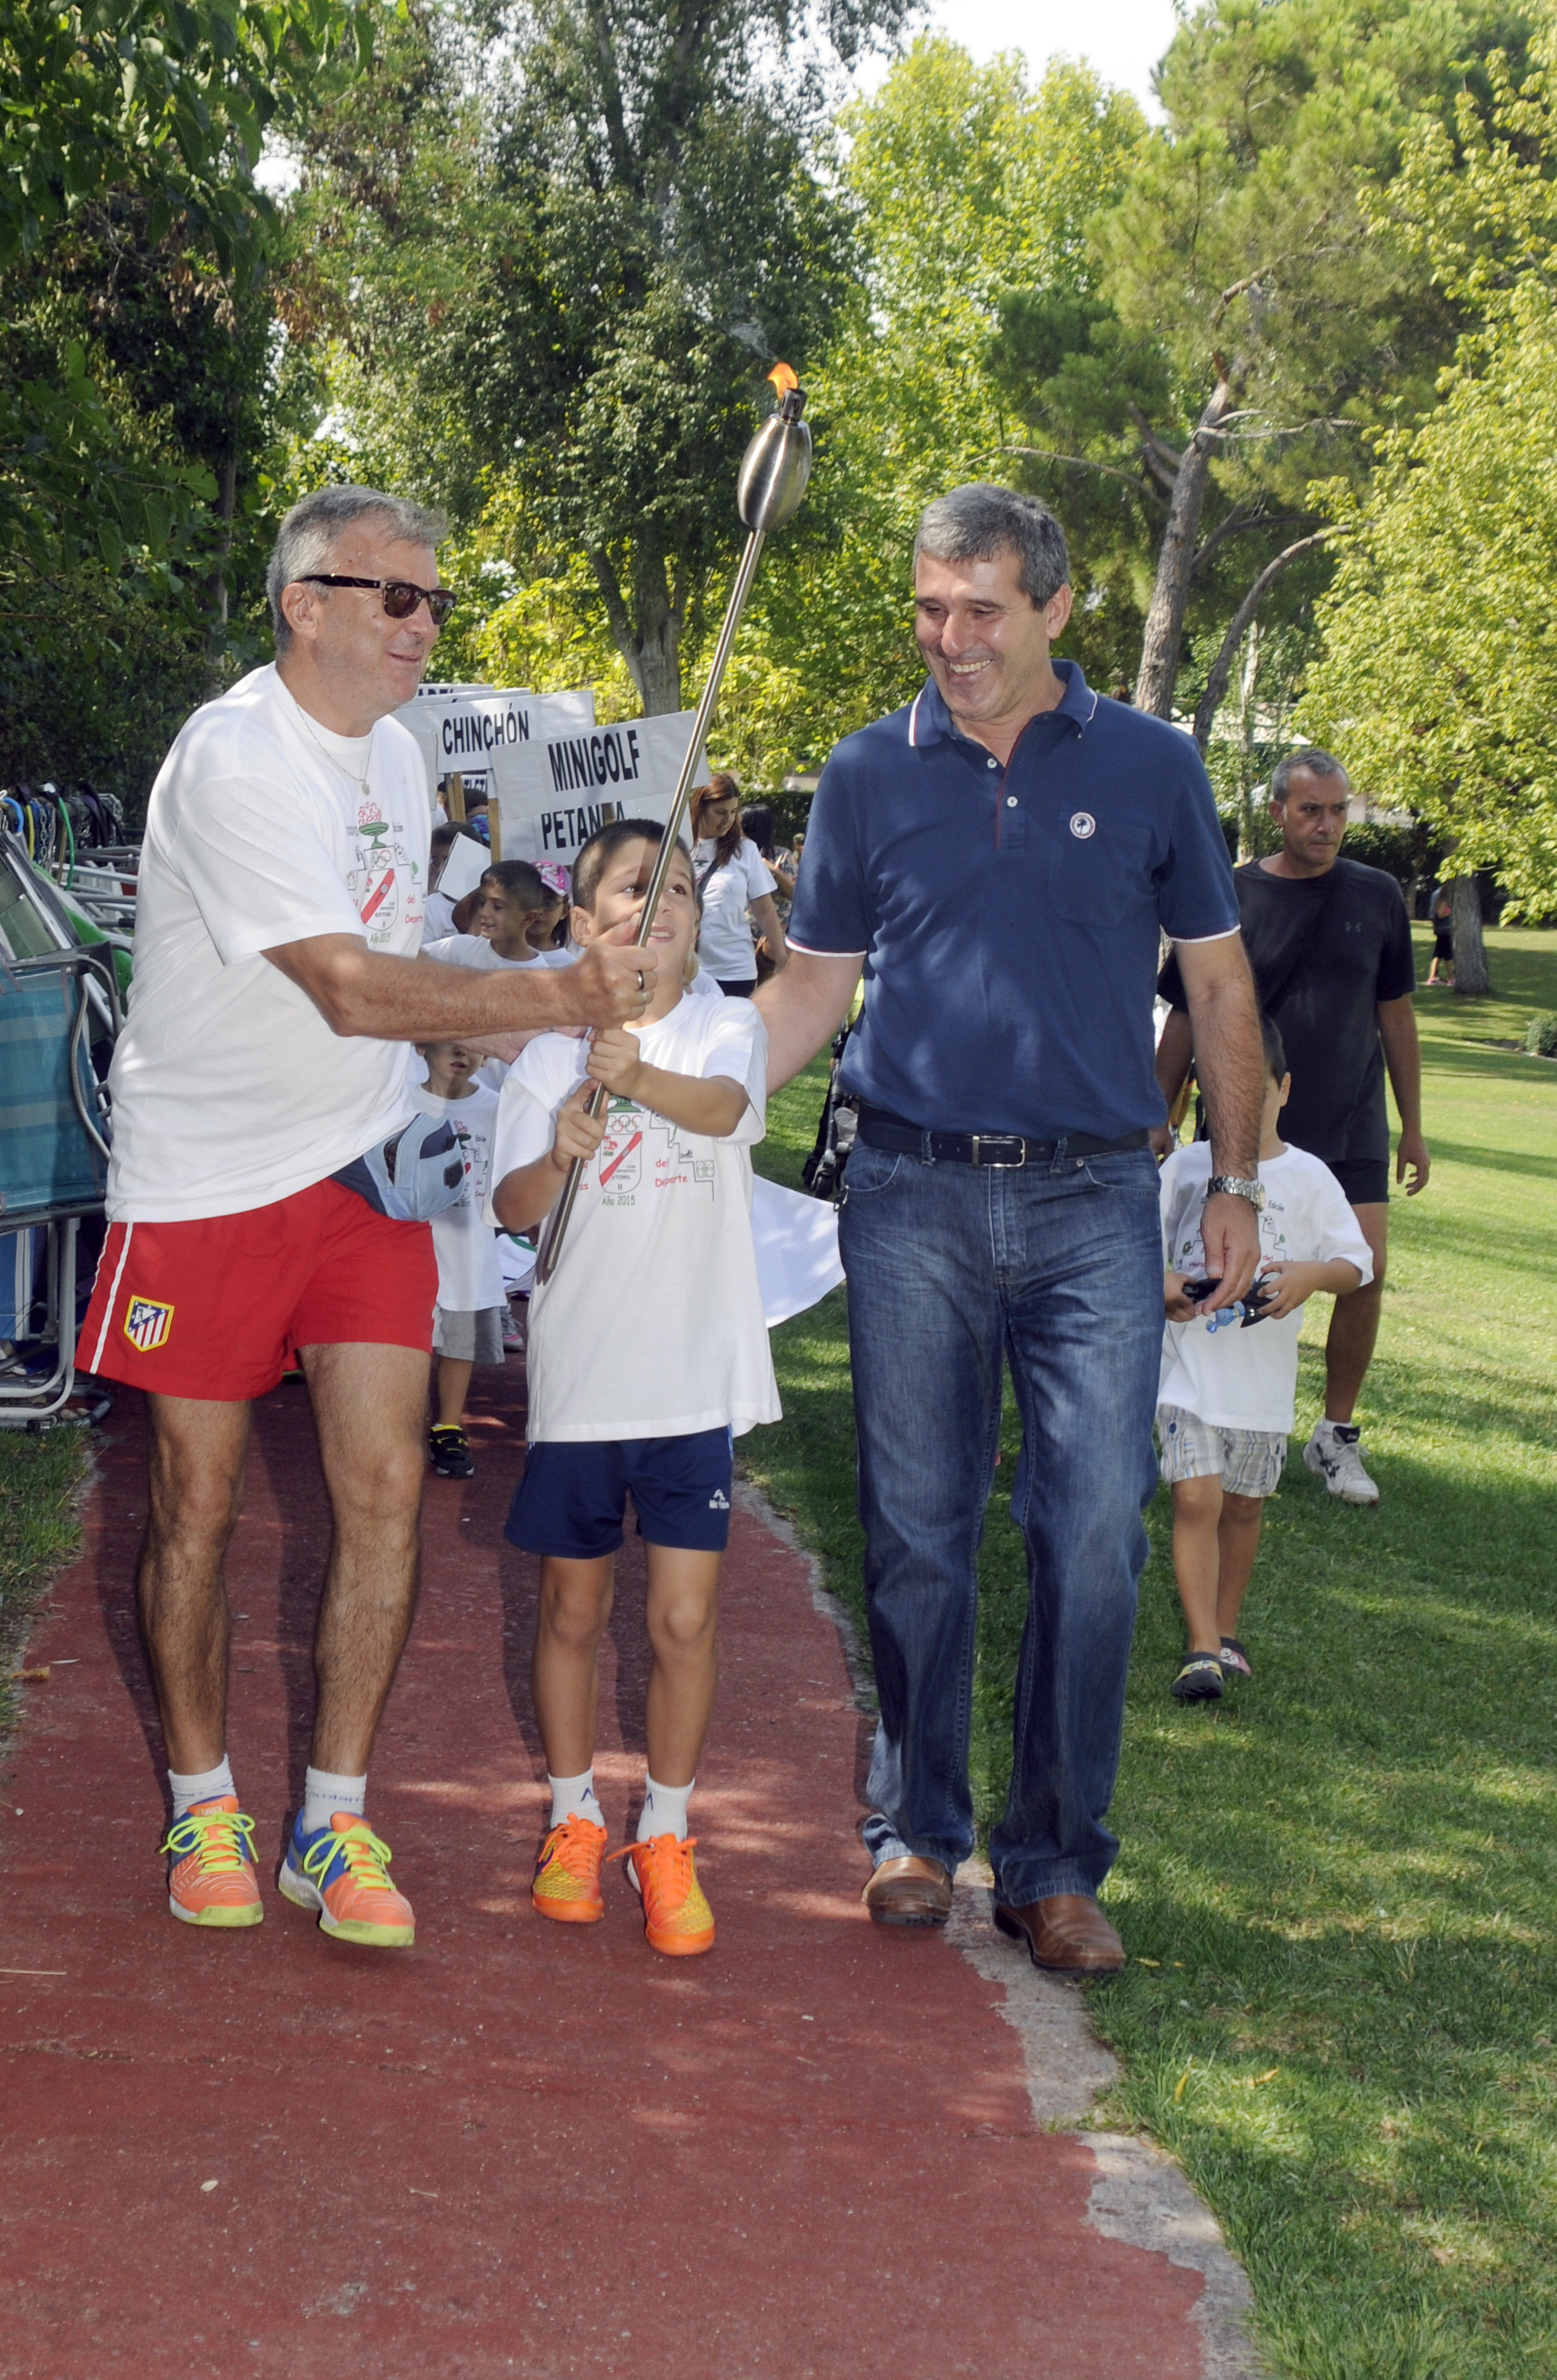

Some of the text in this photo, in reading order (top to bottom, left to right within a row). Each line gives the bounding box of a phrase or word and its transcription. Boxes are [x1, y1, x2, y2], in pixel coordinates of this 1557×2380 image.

[443, 702, 529, 755] CHINCHÓN
[548, 729, 640, 792] MINIGOLF
[541, 801, 625, 850] PETANA
[656, 1159, 670, 1168] del
[654, 1175, 689, 1187] Deporte
[602, 1195, 636, 1206] Año 2015
